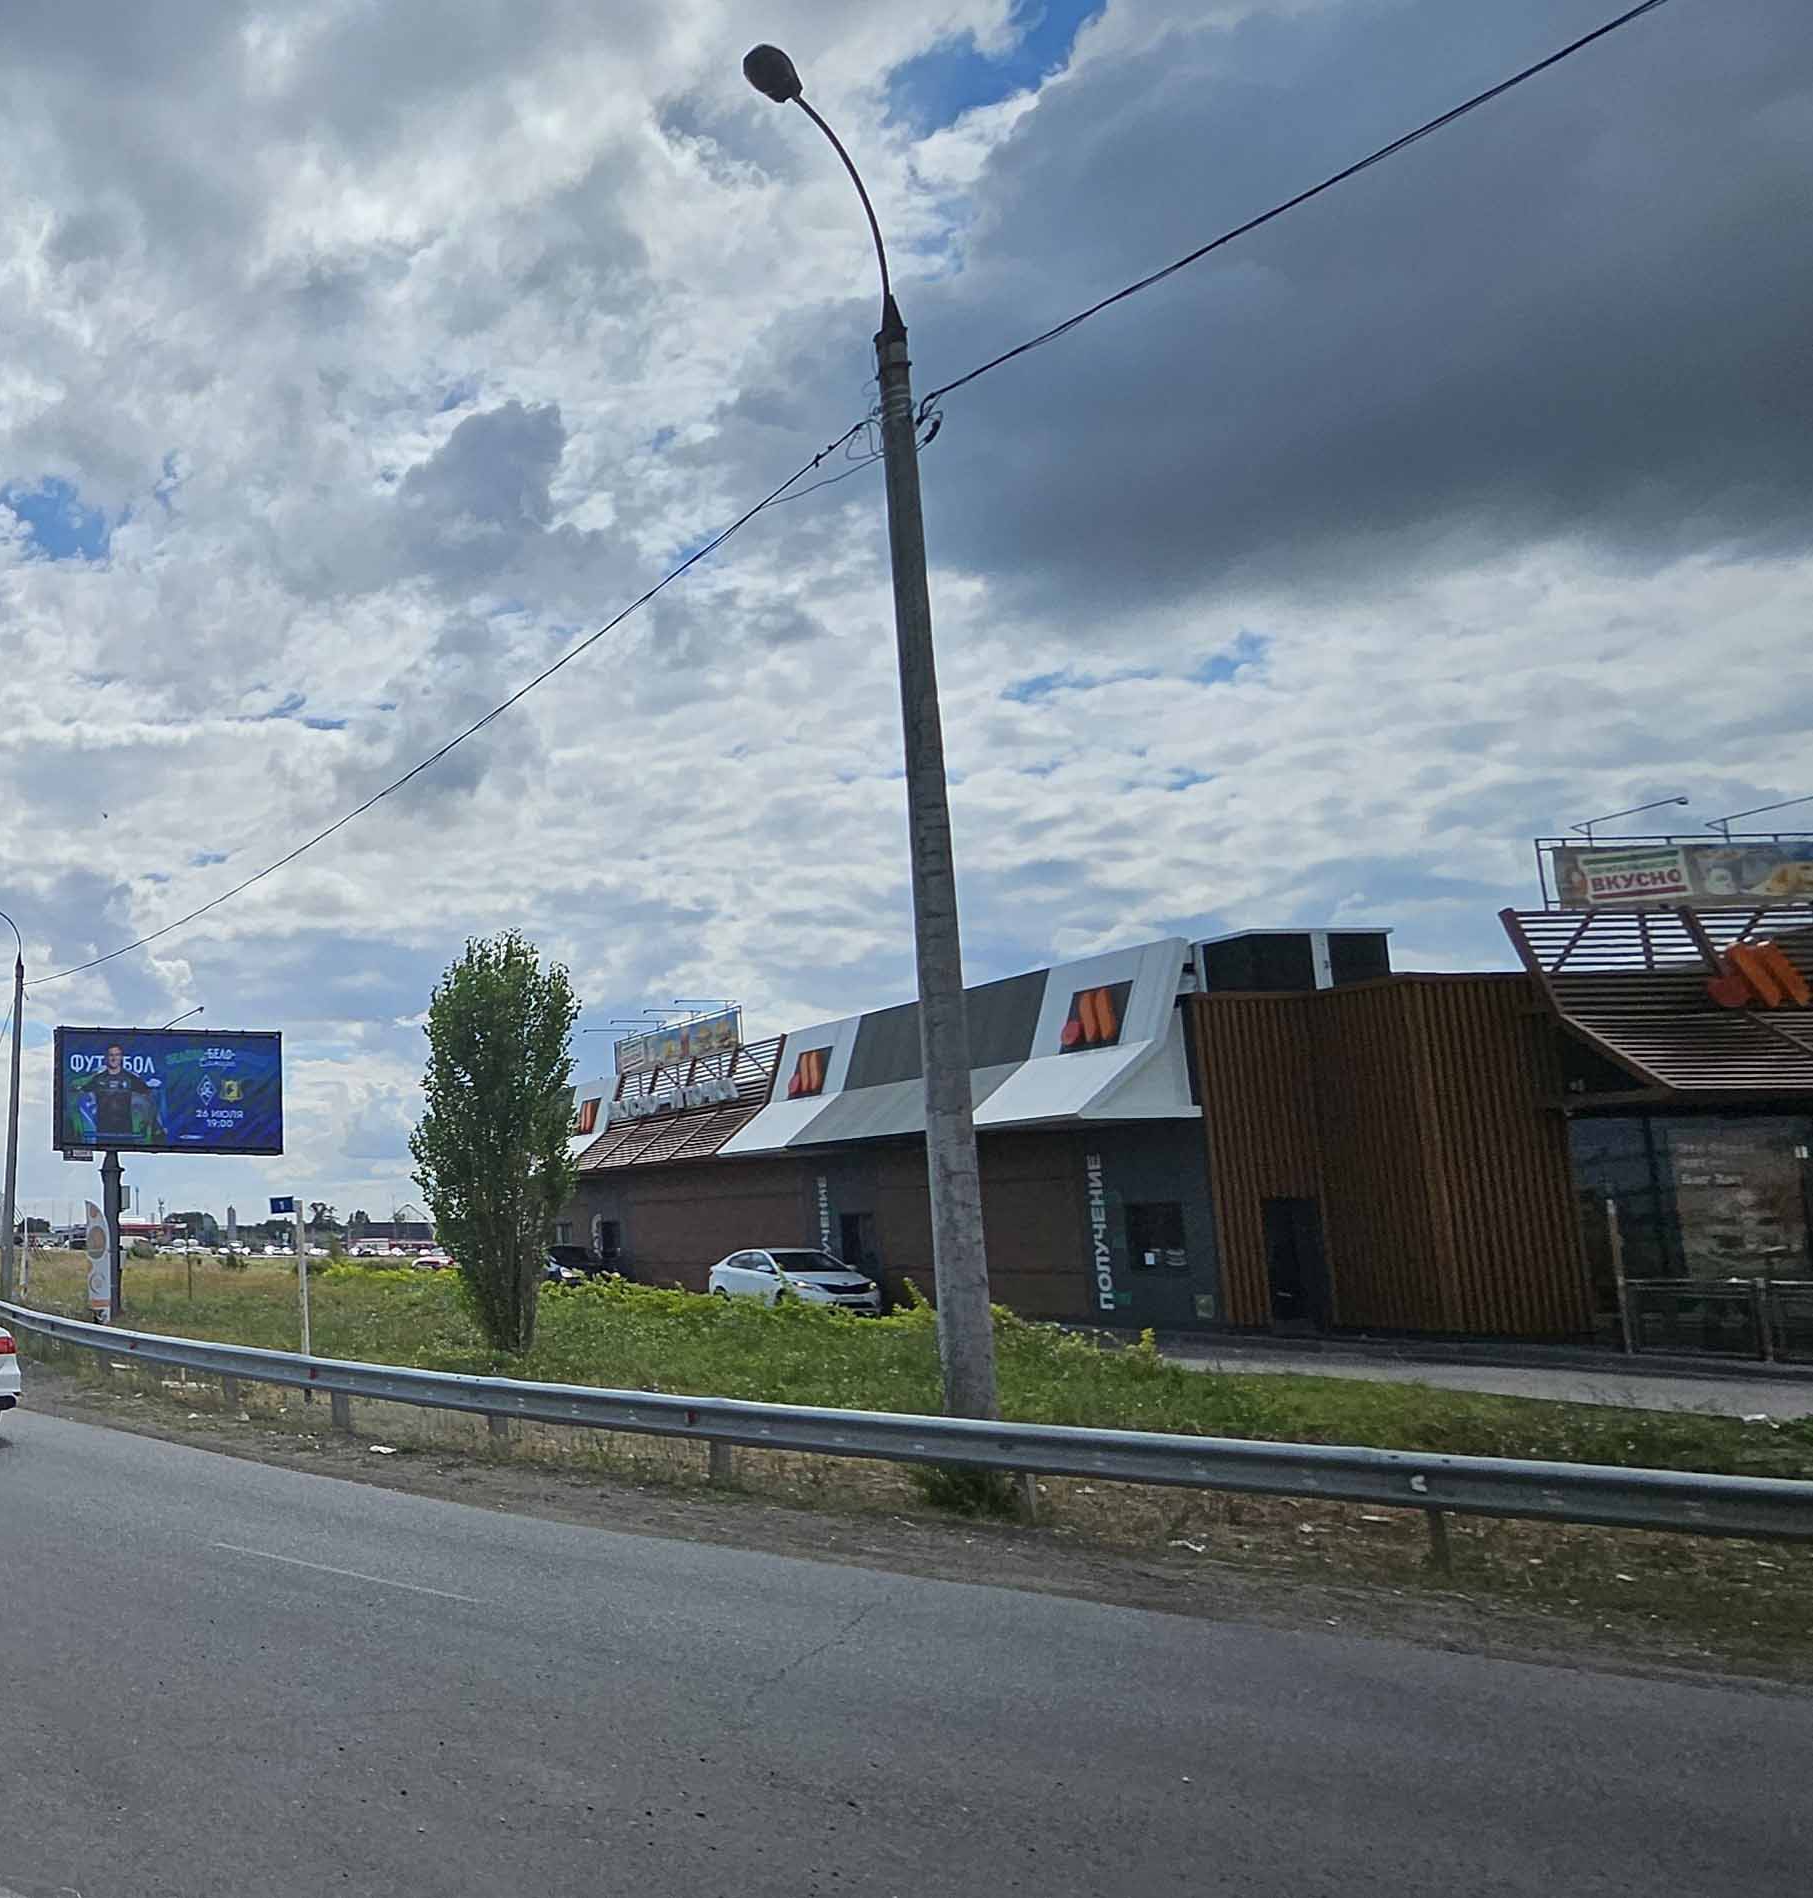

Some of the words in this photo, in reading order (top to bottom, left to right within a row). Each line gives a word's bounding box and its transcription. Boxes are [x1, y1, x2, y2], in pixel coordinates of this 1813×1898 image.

[1590, 868, 1682, 892] ВКУСНО
[195, 1109, 209, 1118] 26
[211, 1109, 244, 1119] ИЮЛЯ
[205, 1119, 234, 1128] 19:00
[817, 1176, 831, 1253] УЧЕНИЕ
[1087, 1153, 1115, 1310] ПОЛУЧЕНИЕ
